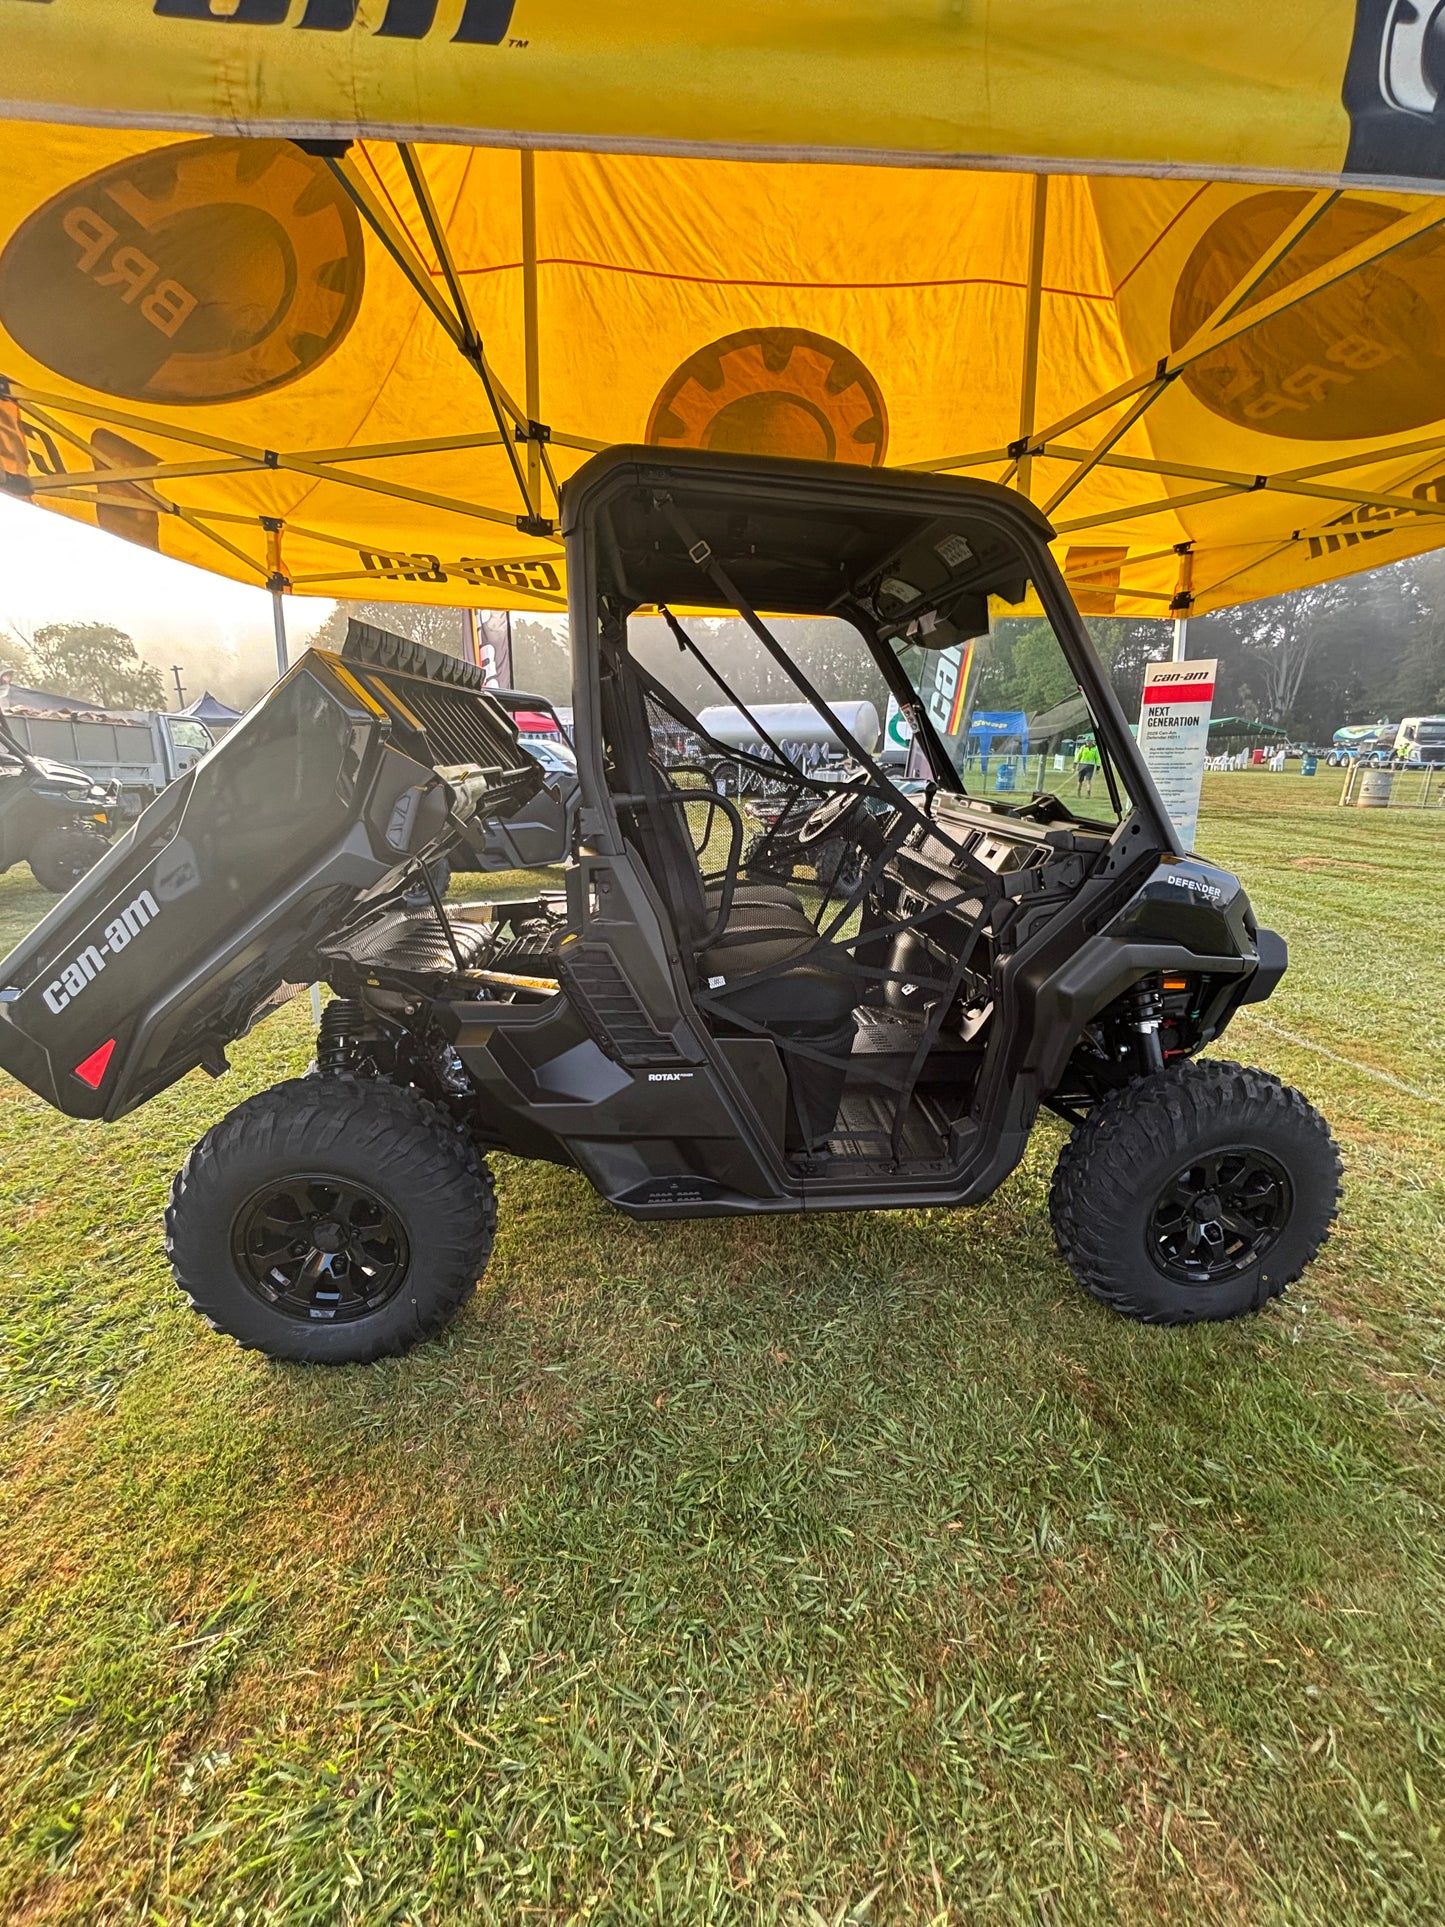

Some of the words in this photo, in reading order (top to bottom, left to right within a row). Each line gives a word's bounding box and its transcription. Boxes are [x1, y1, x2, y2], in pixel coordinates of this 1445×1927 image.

[1152, 671, 1209, 683] can-am
[1148, 707, 1170, 717] NEXT
[1147, 716, 1200, 728] GENERATION
[1167, 875, 1221, 897] DEFENDER
[1201, 893, 1219, 902] XT
[42, 889, 160, 1014] can-am
[648, 1073, 681, 1081] ROTAX
